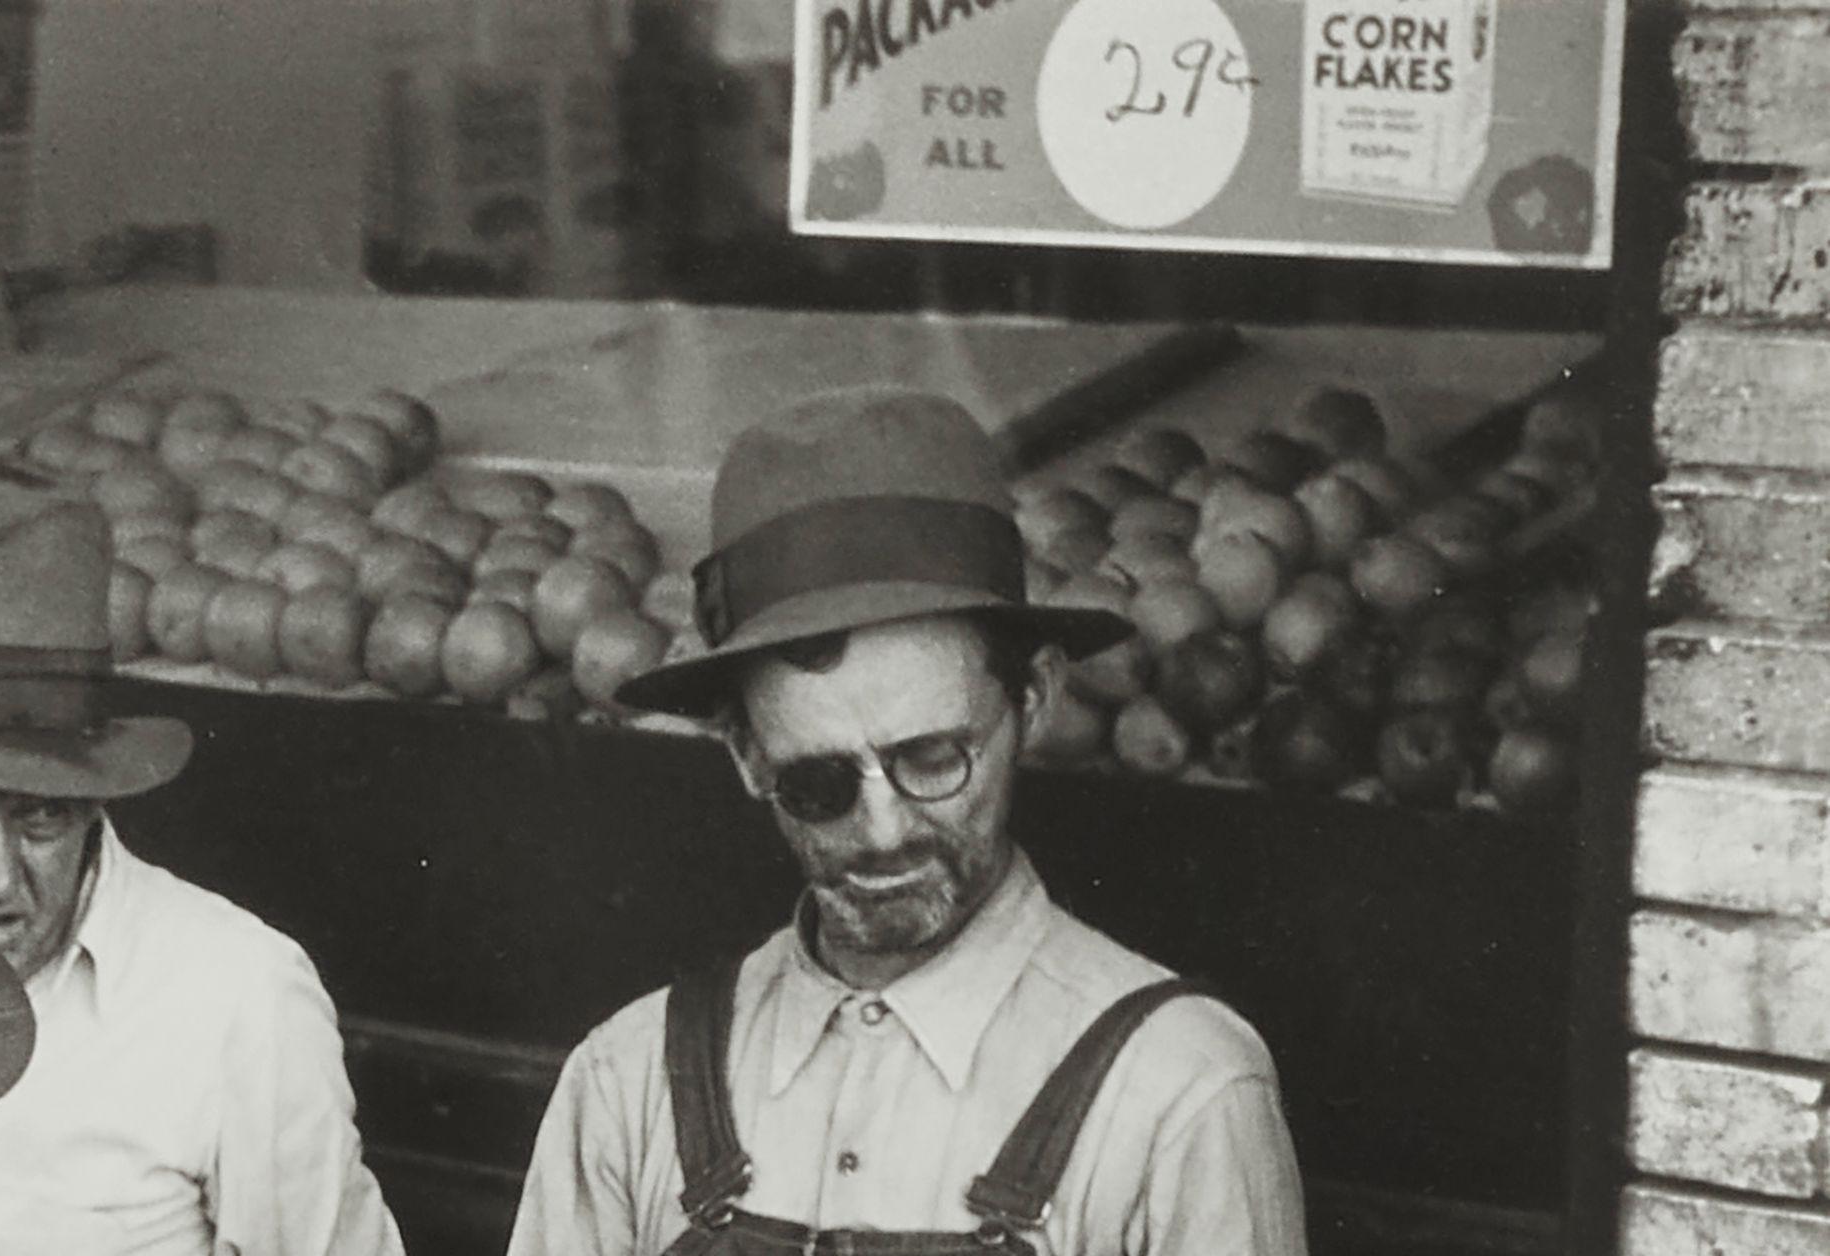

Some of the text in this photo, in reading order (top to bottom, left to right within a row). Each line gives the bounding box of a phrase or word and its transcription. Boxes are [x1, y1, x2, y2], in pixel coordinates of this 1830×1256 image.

[1322, 13, 1448, 51] CORN
[1314, 53, 1454, 93] FLAKES
[921, 83, 1006, 118] FOR
[926, 136, 1006, 171] ALL
